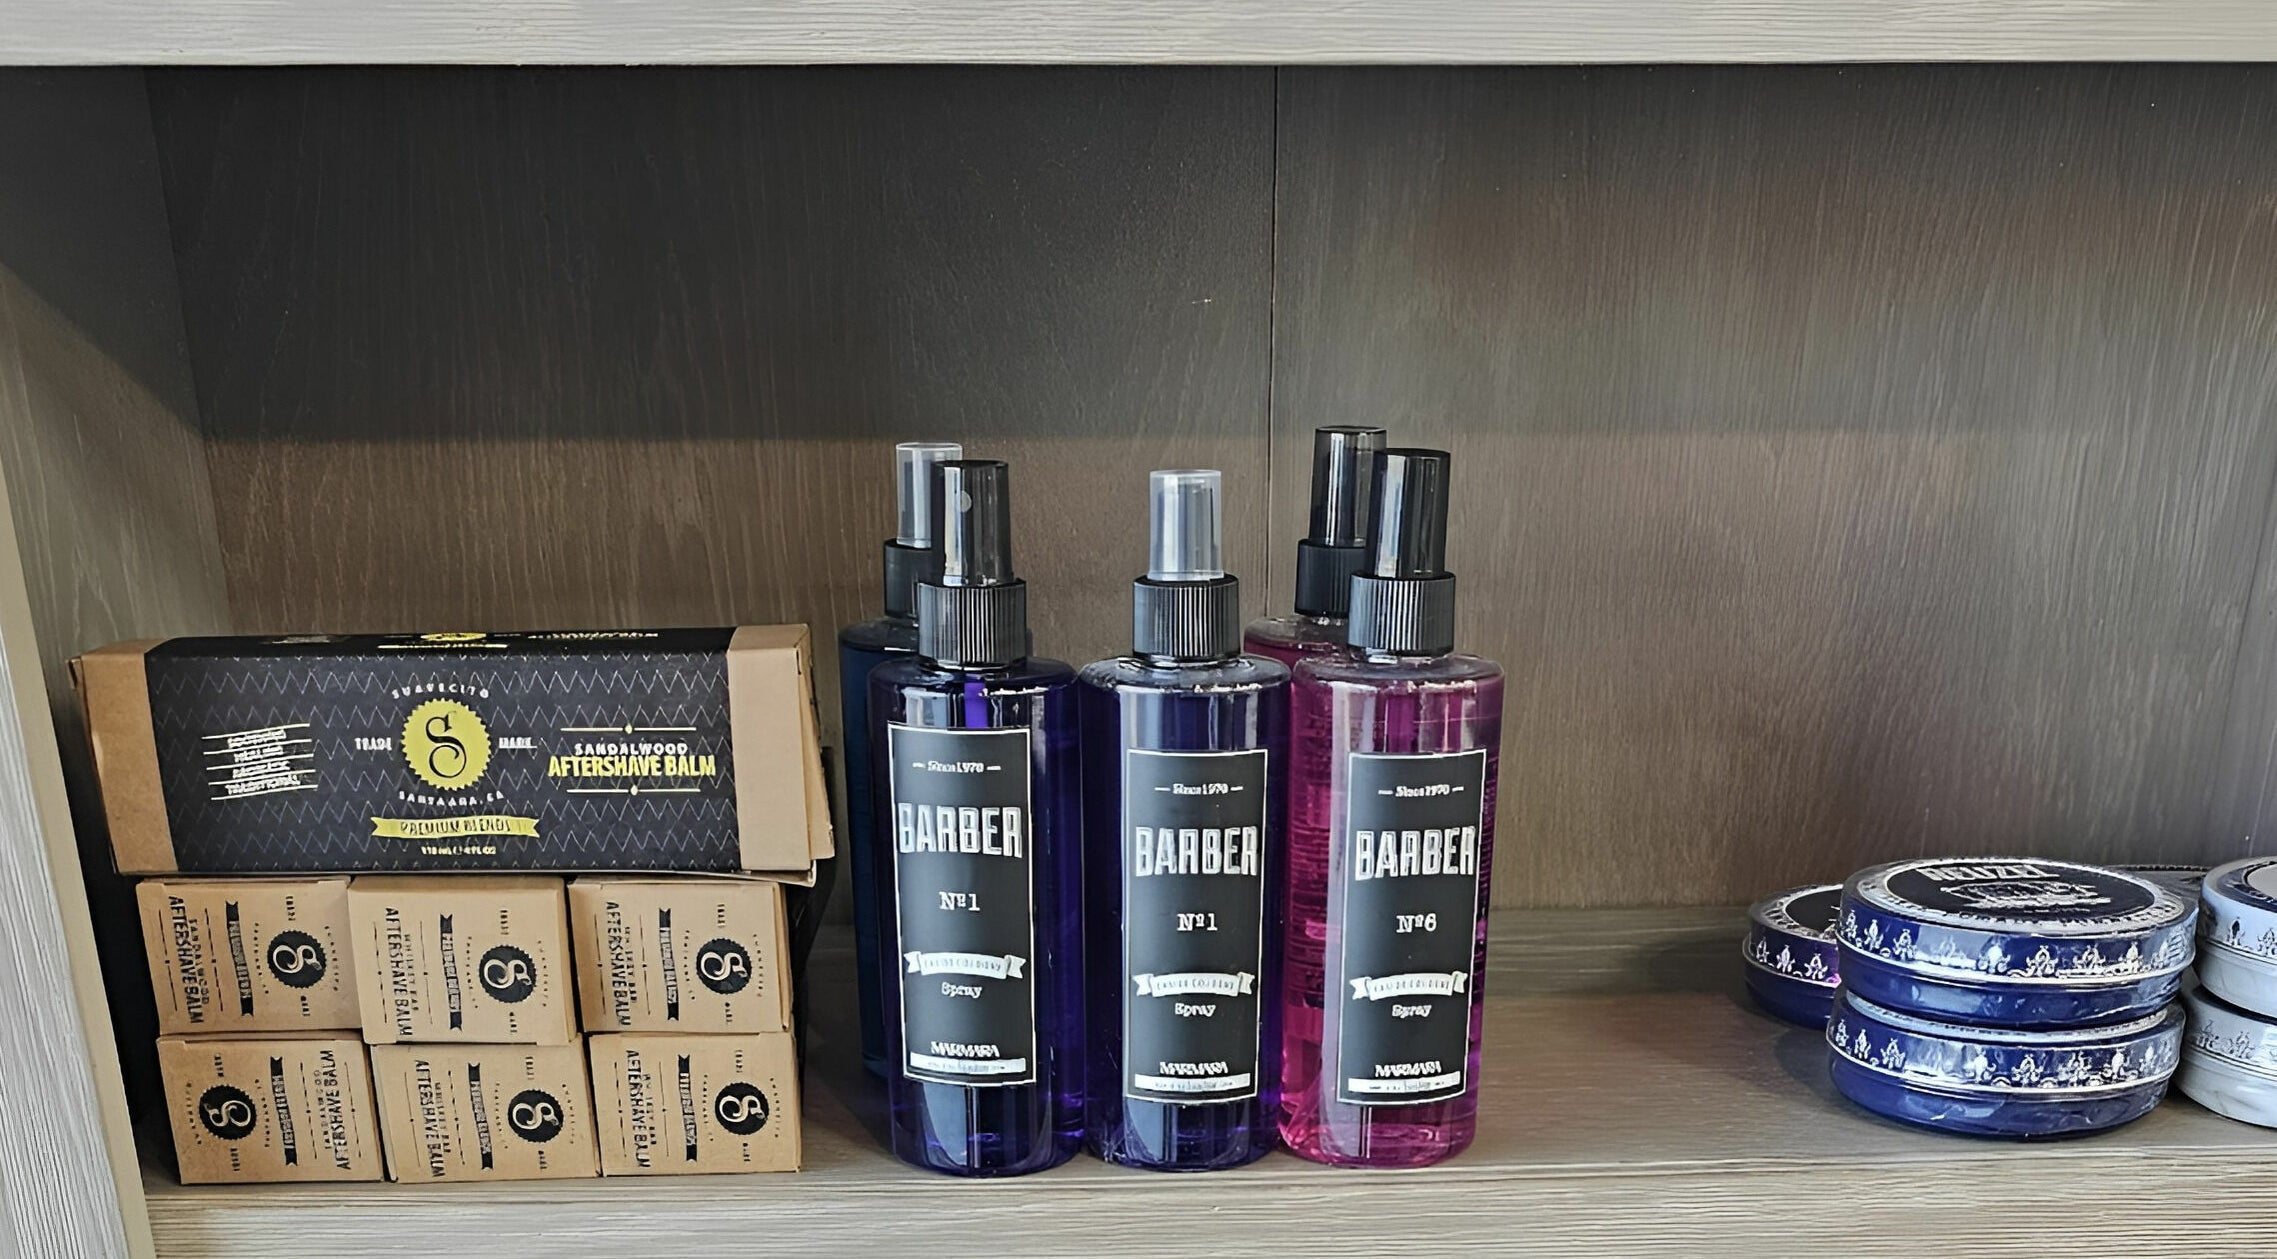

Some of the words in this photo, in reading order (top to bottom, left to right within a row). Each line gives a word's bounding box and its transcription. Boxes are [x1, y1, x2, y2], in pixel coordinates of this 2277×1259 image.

[392, 683, 489, 699] SUAVECITO
[354, 737, 392, 751] TRADE
[575, 743, 688, 756] SANDALWOOD
[548, 755, 662, 777] AFTERSHAVE
[664, 754, 717, 776] BALM
[898, 803, 1023, 858] BARBER
[1135, 825, 1258, 877] BARBER
[1355, 825, 1476, 881] BARBER
[169, 896, 196, 987] AFTERSHAVE
[184, 987, 204, 1023] BALM
[385, 908, 408, 998] AFTERSHAVE
[606, 902, 628, 989] AFTERSHAVE
[614, 990, 631, 1026] BALM
[941, 981, 982, 999] Spray
[395, 999, 413, 1036] BALM
[1174, 1003, 1216, 1017] Spray
[1392, 1004, 1432, 1019] Spray
[320, 1051, 338, 1086] BALM
[327, 1090, 351, 1170] AFTERSHAVE
